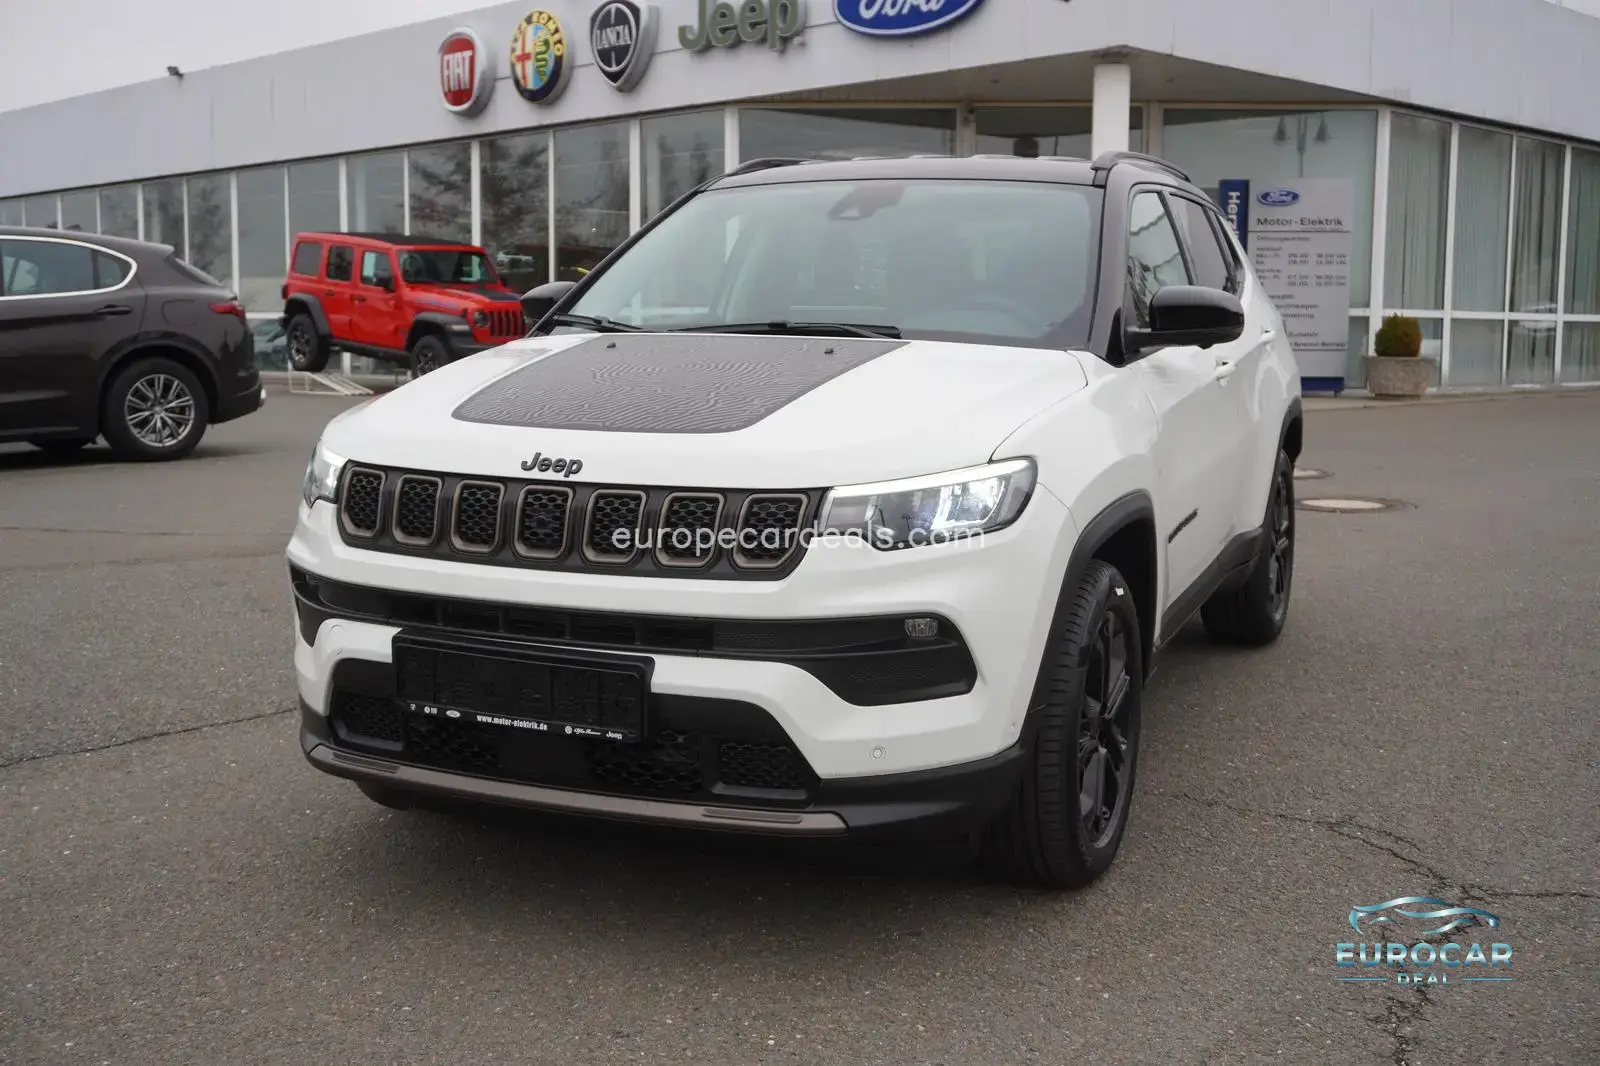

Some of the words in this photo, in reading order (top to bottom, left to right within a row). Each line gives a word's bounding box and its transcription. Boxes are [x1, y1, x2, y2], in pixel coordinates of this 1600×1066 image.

[678, 0, 799, 49] Jeep
[596, 25, 631, 50] LANCIA
[443, 50, 472, 92] FIAT
[521, 452, 583, 478] Jeep
[476, 714, 548, 731] www.motor-elektrik.de
[606, 731, 623, 740] Jeep
